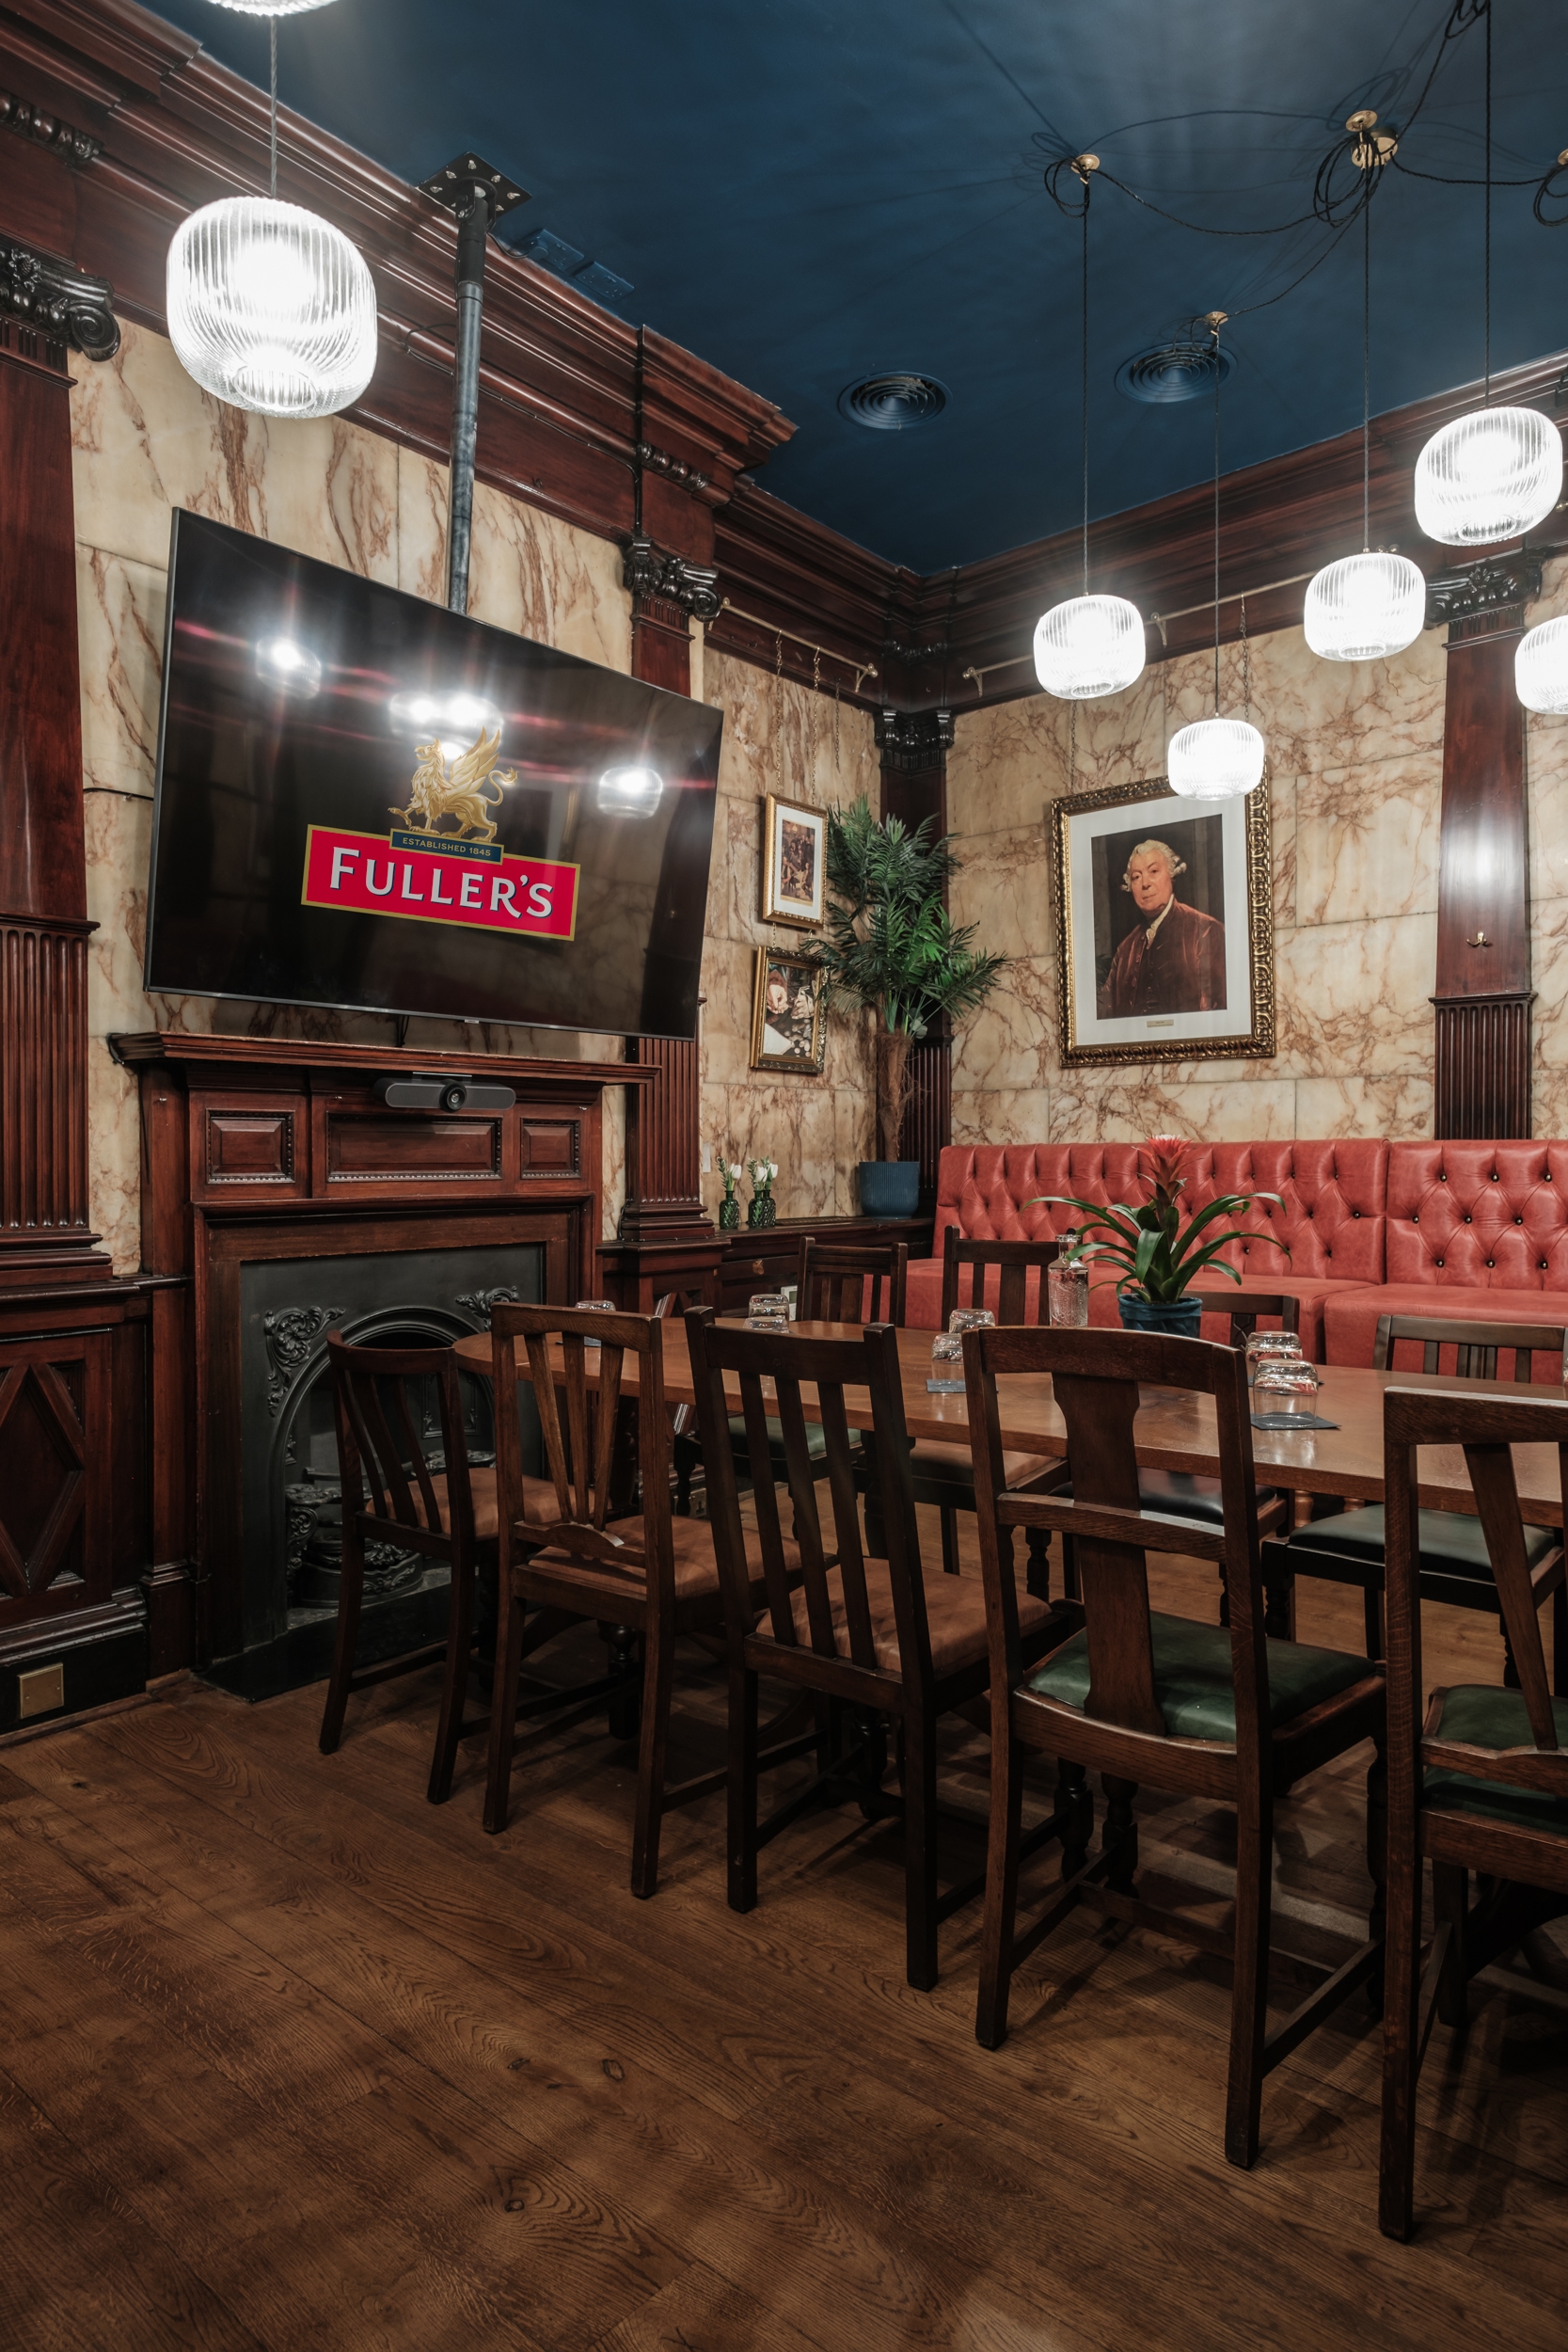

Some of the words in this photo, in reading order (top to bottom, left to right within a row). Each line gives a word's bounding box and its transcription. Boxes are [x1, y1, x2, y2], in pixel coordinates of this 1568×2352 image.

[403, 837, 467, 852] ESTABLISHED
[469, 847, 491, 856] 1845
[330, 847, 553, 918] FULLER'S
